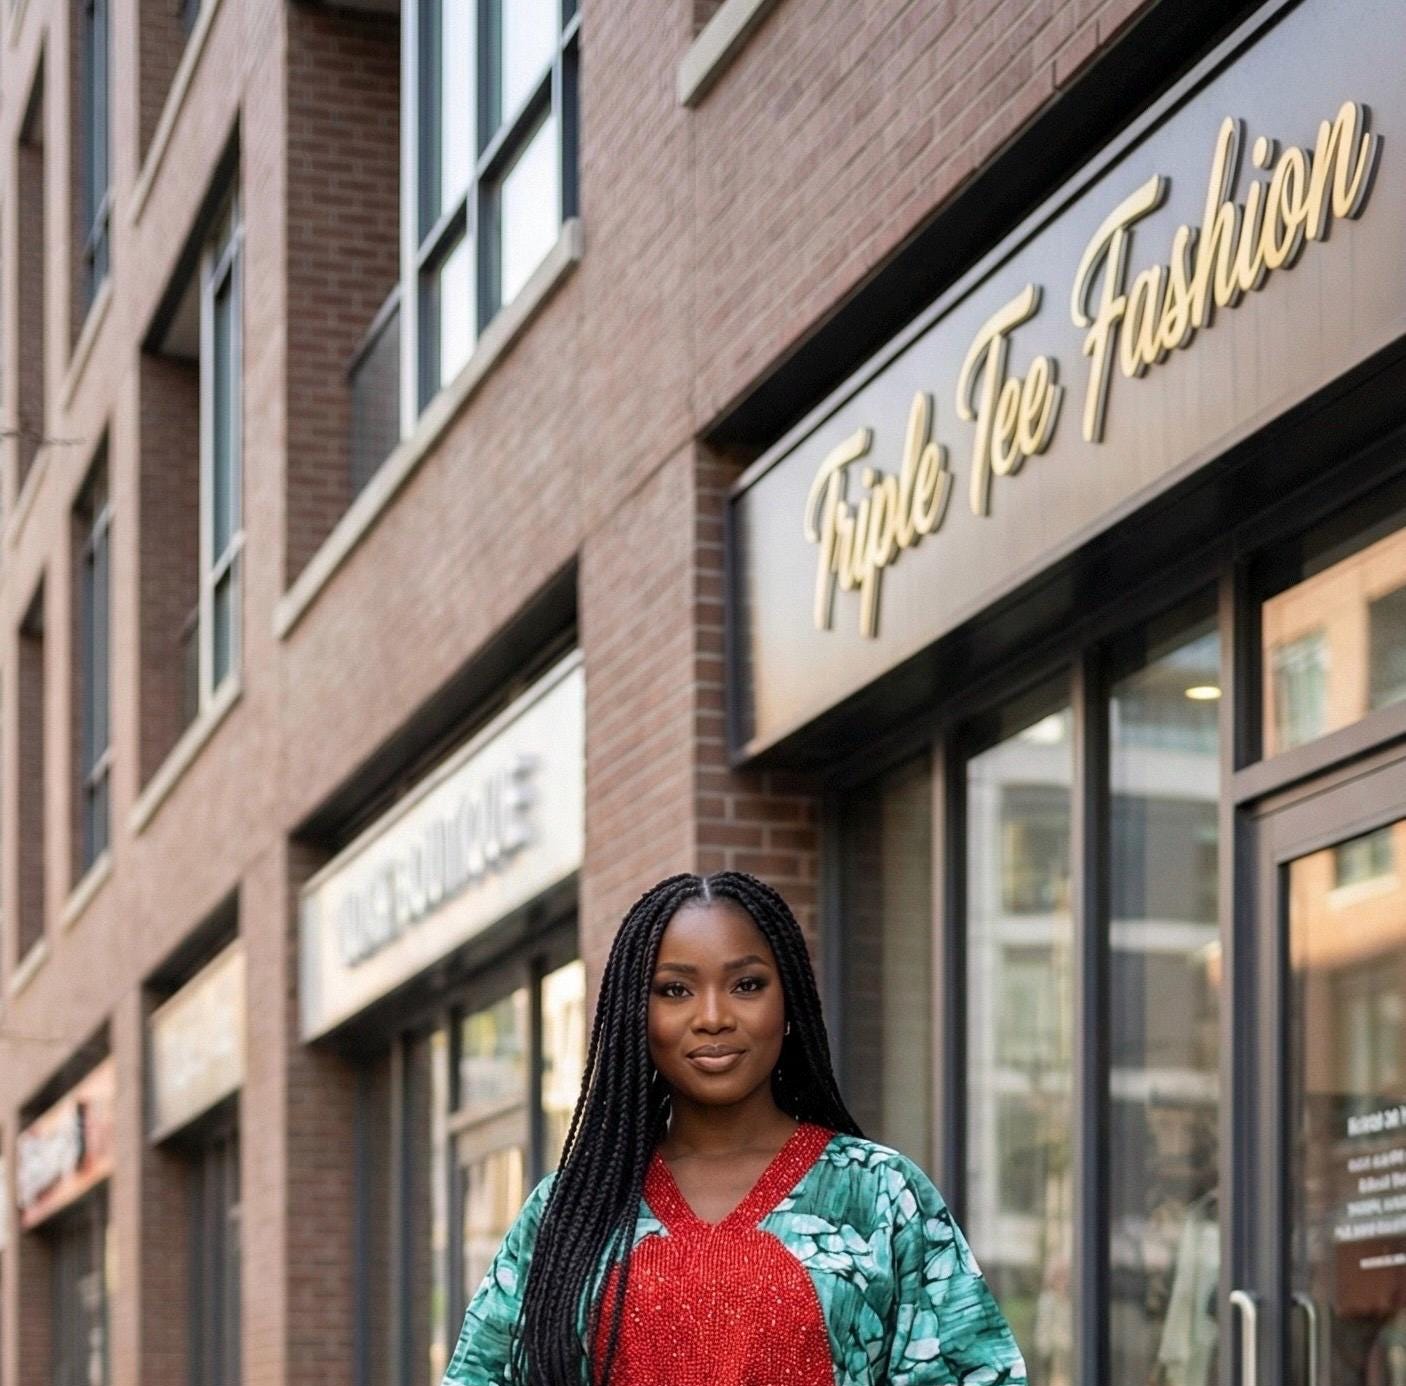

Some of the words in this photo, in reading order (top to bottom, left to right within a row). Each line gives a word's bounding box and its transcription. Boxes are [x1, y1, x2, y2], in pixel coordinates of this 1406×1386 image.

[805, 390, 953, 638] Triple
[956, 282, 1064, 516] Tee
[1071, 100, 1383, 443] Fashion
